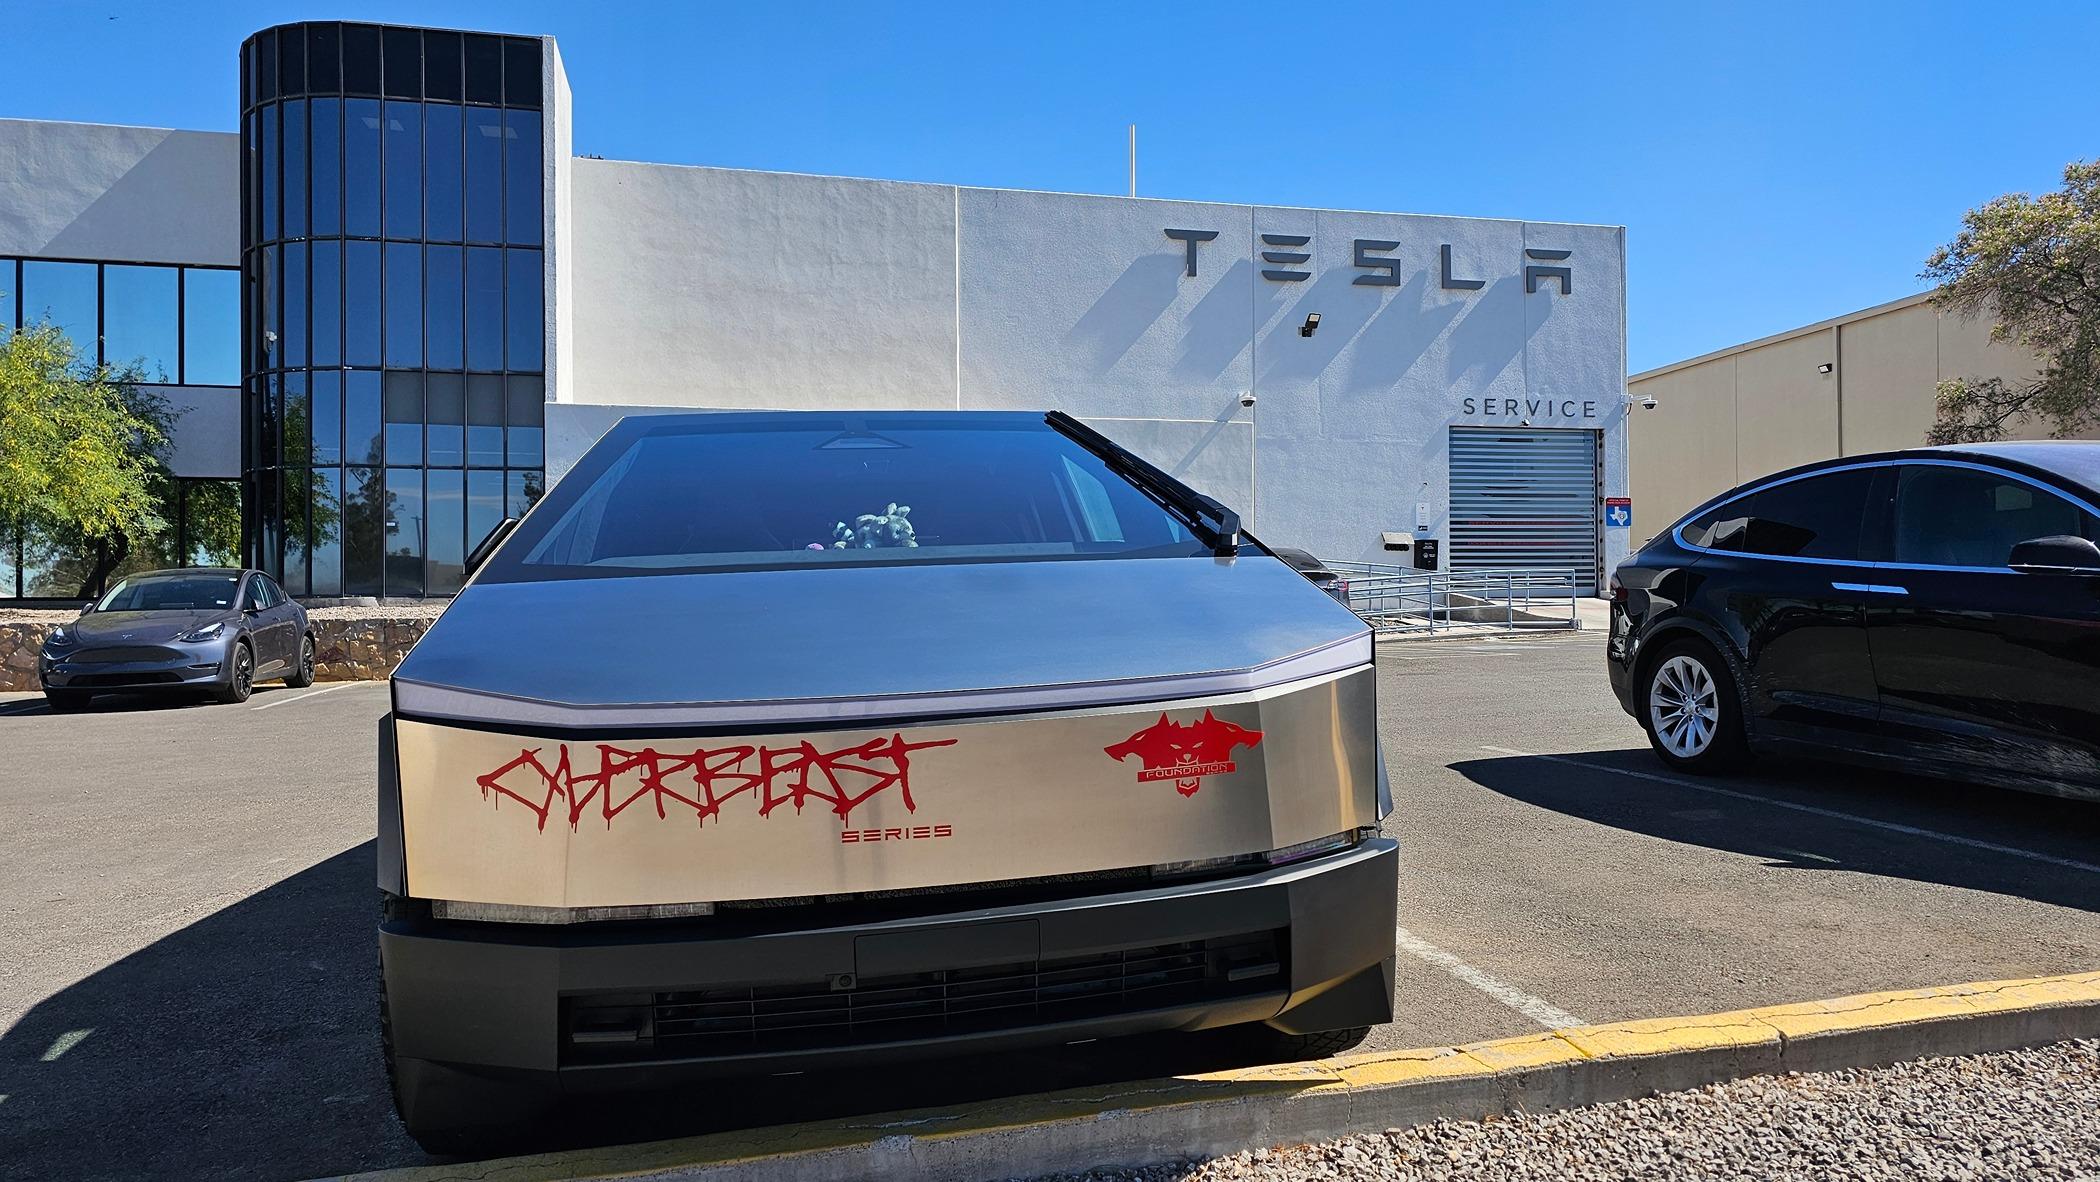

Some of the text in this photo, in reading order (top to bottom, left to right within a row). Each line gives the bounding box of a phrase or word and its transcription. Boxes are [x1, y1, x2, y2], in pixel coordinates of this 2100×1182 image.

[1163, 228, 1573, 295] TESLA
[1463, 397, 1596, 419] SERVICE
[1146, 763, 1228, 779] FOUNDATION
[476, 732, 958, 834] CYBERBEAST
[841, 824, 953, 844] SERIES
